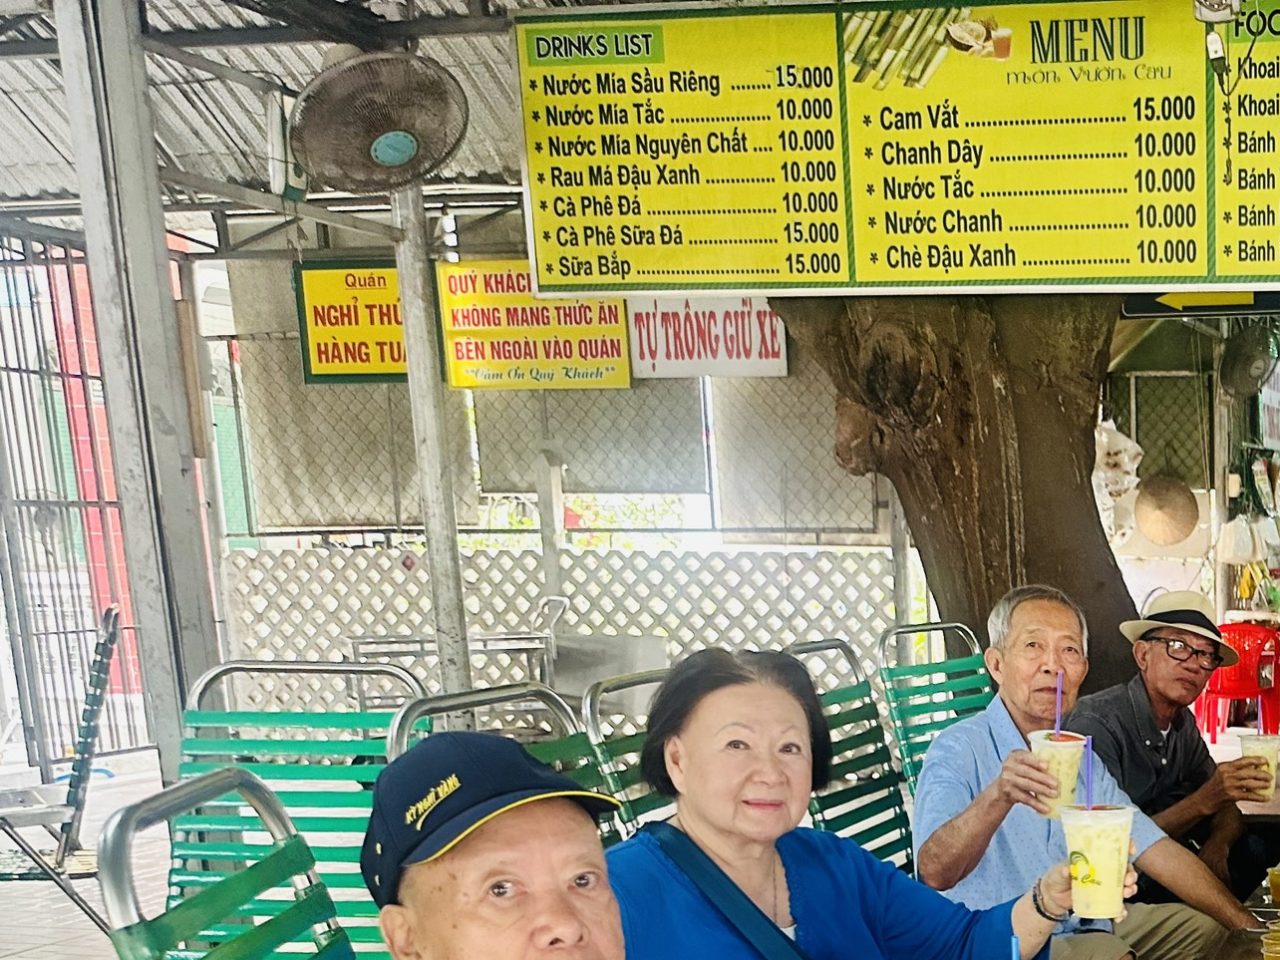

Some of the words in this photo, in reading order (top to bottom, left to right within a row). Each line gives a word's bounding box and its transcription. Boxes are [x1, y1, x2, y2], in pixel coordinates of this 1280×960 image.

[536, 34, 608, 59] DRINKS
[615, 33, 654, 56] LIST
[1030, 16, 1146, 64] MENU
[543, 73, 591, 96] Nước
[596, 72, 626, 94] Mía
[631, 67, 664, 93] Sầu
[670, 70, 720, 97] Riêng
[776, 64, 834, 89] 15.000
[1238, 55, 1280, 79] Khoai
[880, 106, 922, 131] Cam
[927, 99, 960, 130] Vắt
[1133, 95, 1195, 122] 15.000
[549, 135, 596, 158] Nước
[601, 133, 631, 156] Mía
[636, 133, 701, 160] Nguyên
[707, 127, 748, 153] Chất
[778, 129, 835, 152] 10.000
[882, 141, 941, 166] Chanh
[947, 139, 984, 169] Dây
[1134, 132, 1196, 158] 10.000
[1238, 131, 1276, 154] Bánh
[551, 165, 584, 187] Rau
[589, 164, 613, 186] Má
[617, 163, 651, 190] Đậu
[657, 163, 700, 185] Xanh
[781, 160, 836, 183] 10.000
[883, 175, 935, 200] Nước
[940, 169, 974, 199] Tắc
[1134, 167, 1196, 193] 10.000
[1238, 166, 1276, 191] Bánh
[1238, 201, 1276, 226] Bánh
[556, 225, 579, 247] Cà
[583, 224, 616, 246] Phê
[620, 224, 655, 245] Sữa
[660, 223, 684, 245] Đá
[783, 222, 839, 245] 15.000
[559, 255, 593, 276] Sữa
[599, 251, 631, 279] Bắp
[785, 253, 841, 275] 15.000
[886, 244, 922, 269] Chè
[927, 244, 963, 273] Đậu
[969, 243, 1016, 267] Xanh
[1136, 239, 1197, 264] 10.000
[345, 273, 387, 289] Quán
[448, 272, 478, 295] QUÝ
[313, 296, 359, 327] NGHỈ
[451, 305, 501, 328] KHÔNG
[506, 306, 551, 327] MANG
[554, 299, 594, 325] THỨC
[598, 300, 619, 325] ĂN
[661, 297, 721, 361] TRÔNG
[757, 309, 782, 360] XE
[317, 335, 371, 364] HÀNG
[375, 341, 407, 363] TU
[454, 337, 486, 361] BÊN
[495, 335, 538, 360] NGOÀI
[543, 335, 574, 360] VÀO
[578, 334, 622, 361] QUÁN
